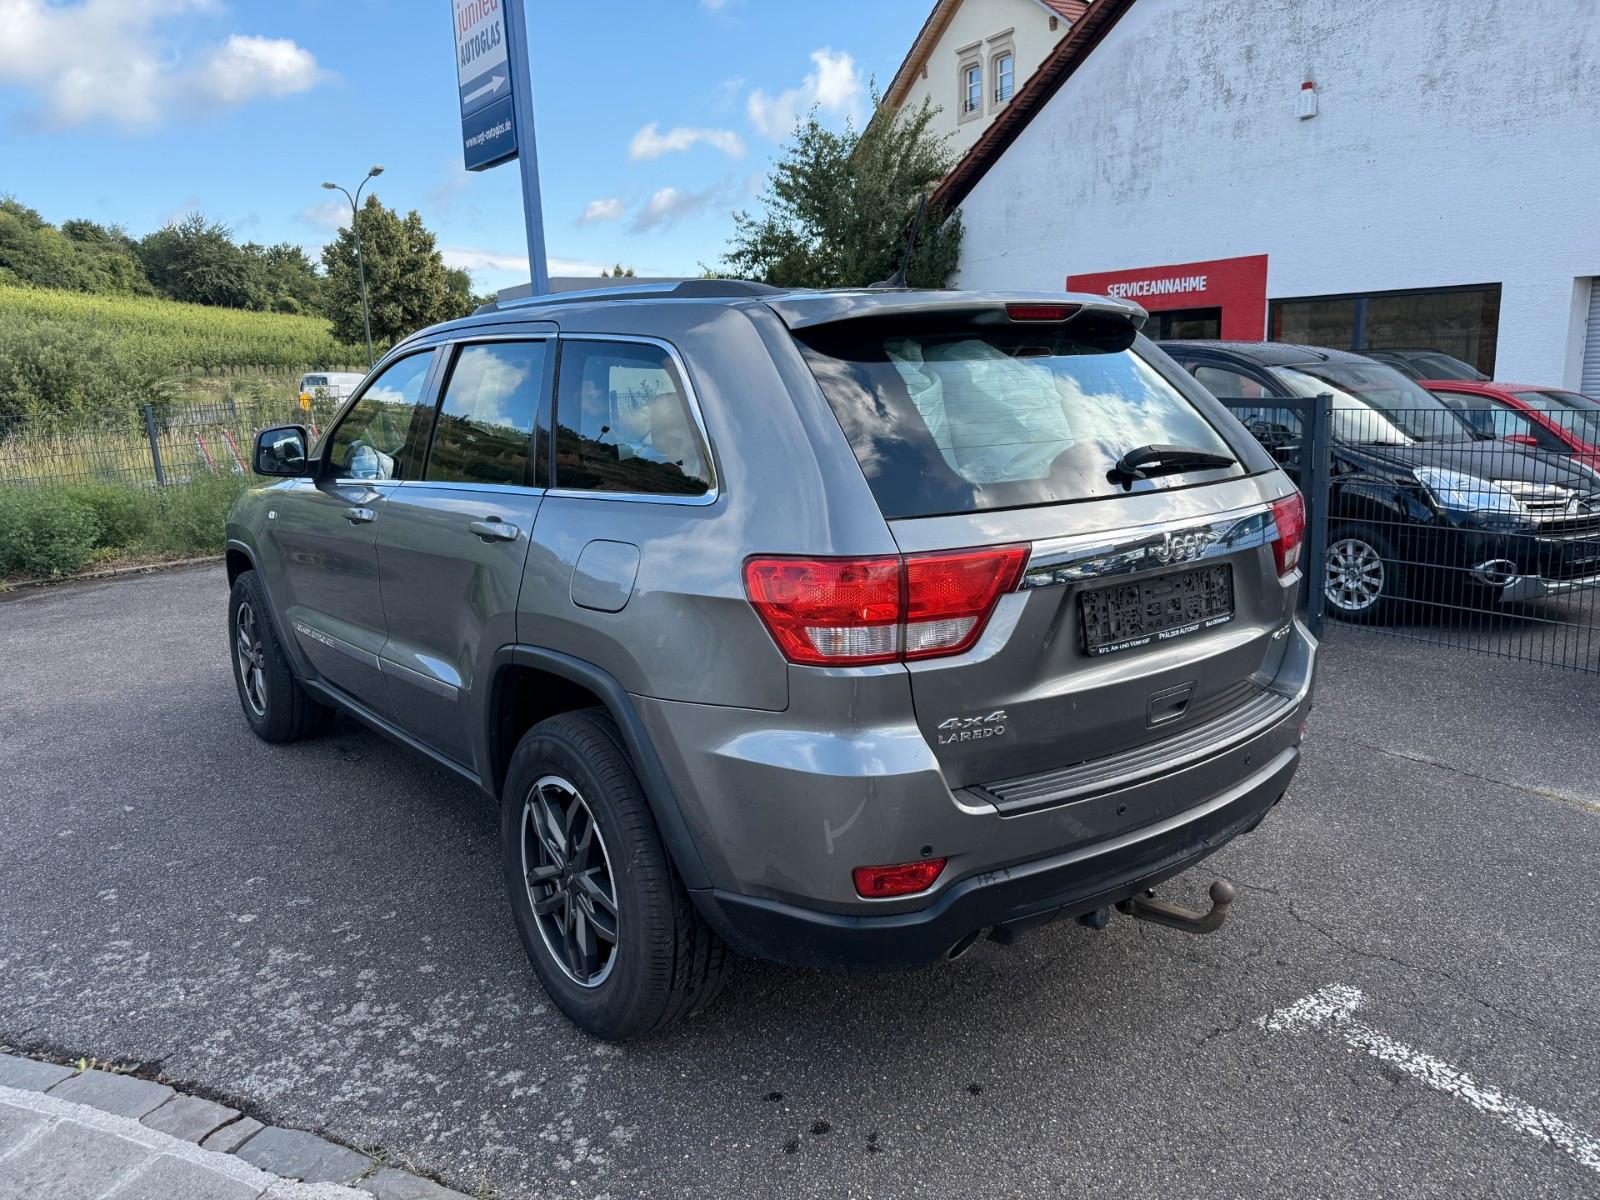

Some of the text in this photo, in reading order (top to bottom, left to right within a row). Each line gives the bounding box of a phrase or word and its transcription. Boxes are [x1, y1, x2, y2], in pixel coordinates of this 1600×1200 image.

[461, 20, 501, 68] AUTOGLAS
[1107, 275, 1207, 298] SERVICEANNAHME
[1157, 533, 1209, 563] Jeep
[938, 725, 1006, 745] LAREDO
